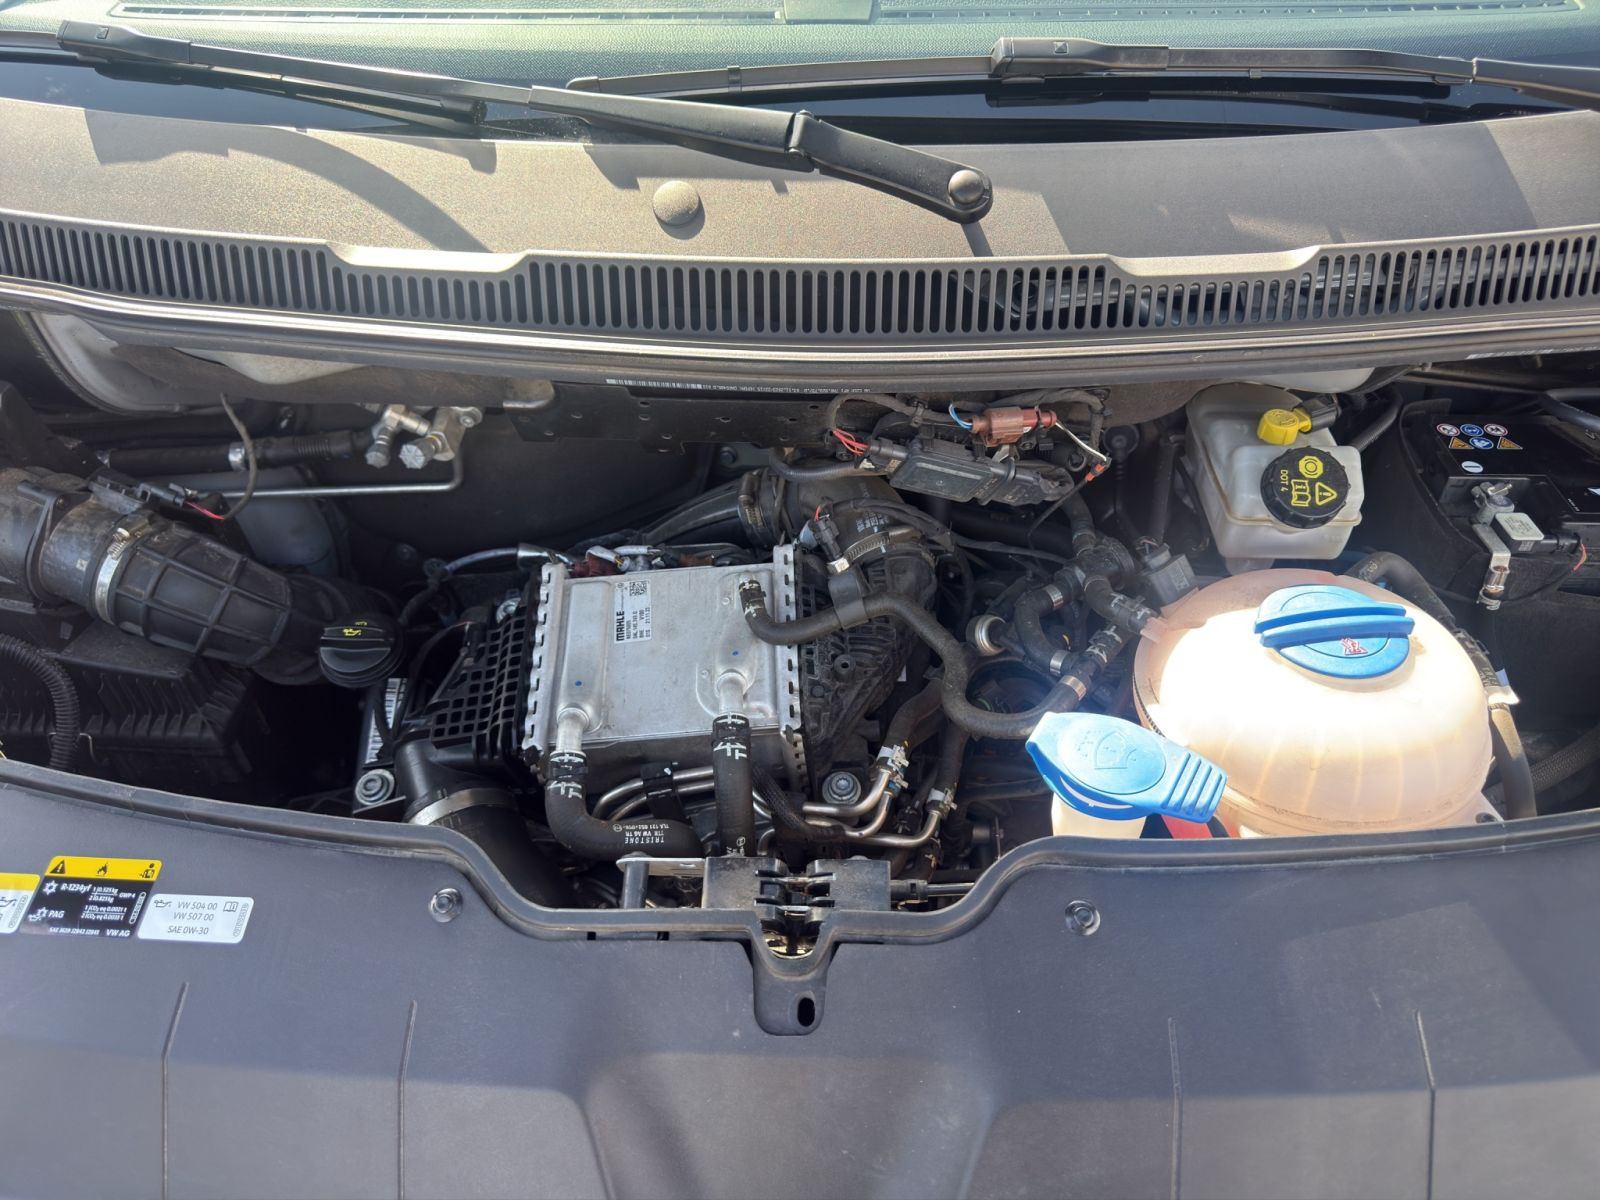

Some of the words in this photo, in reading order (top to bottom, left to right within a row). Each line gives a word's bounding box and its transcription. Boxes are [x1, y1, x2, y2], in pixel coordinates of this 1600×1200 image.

[1280, 470, 1288, 485] DOT
[616, 611, 625, 641] MAHLE
[60, 883, 92, 893] R-1234yf
[177, 901, 190, 909] VW
[191, 902, 206, 910] 504
[207, 902, 217, 910] 00
[48, 910, 65, 918] PAG
[187, 912, 202, 920] 507
[203, 913, 214, 921] 00
[106, 928, 118, 936] VW
[119, 929, 130, 937] AG
[168, 925, 182, 933] SAE
[183, 926, 208, 935] 0W-30
